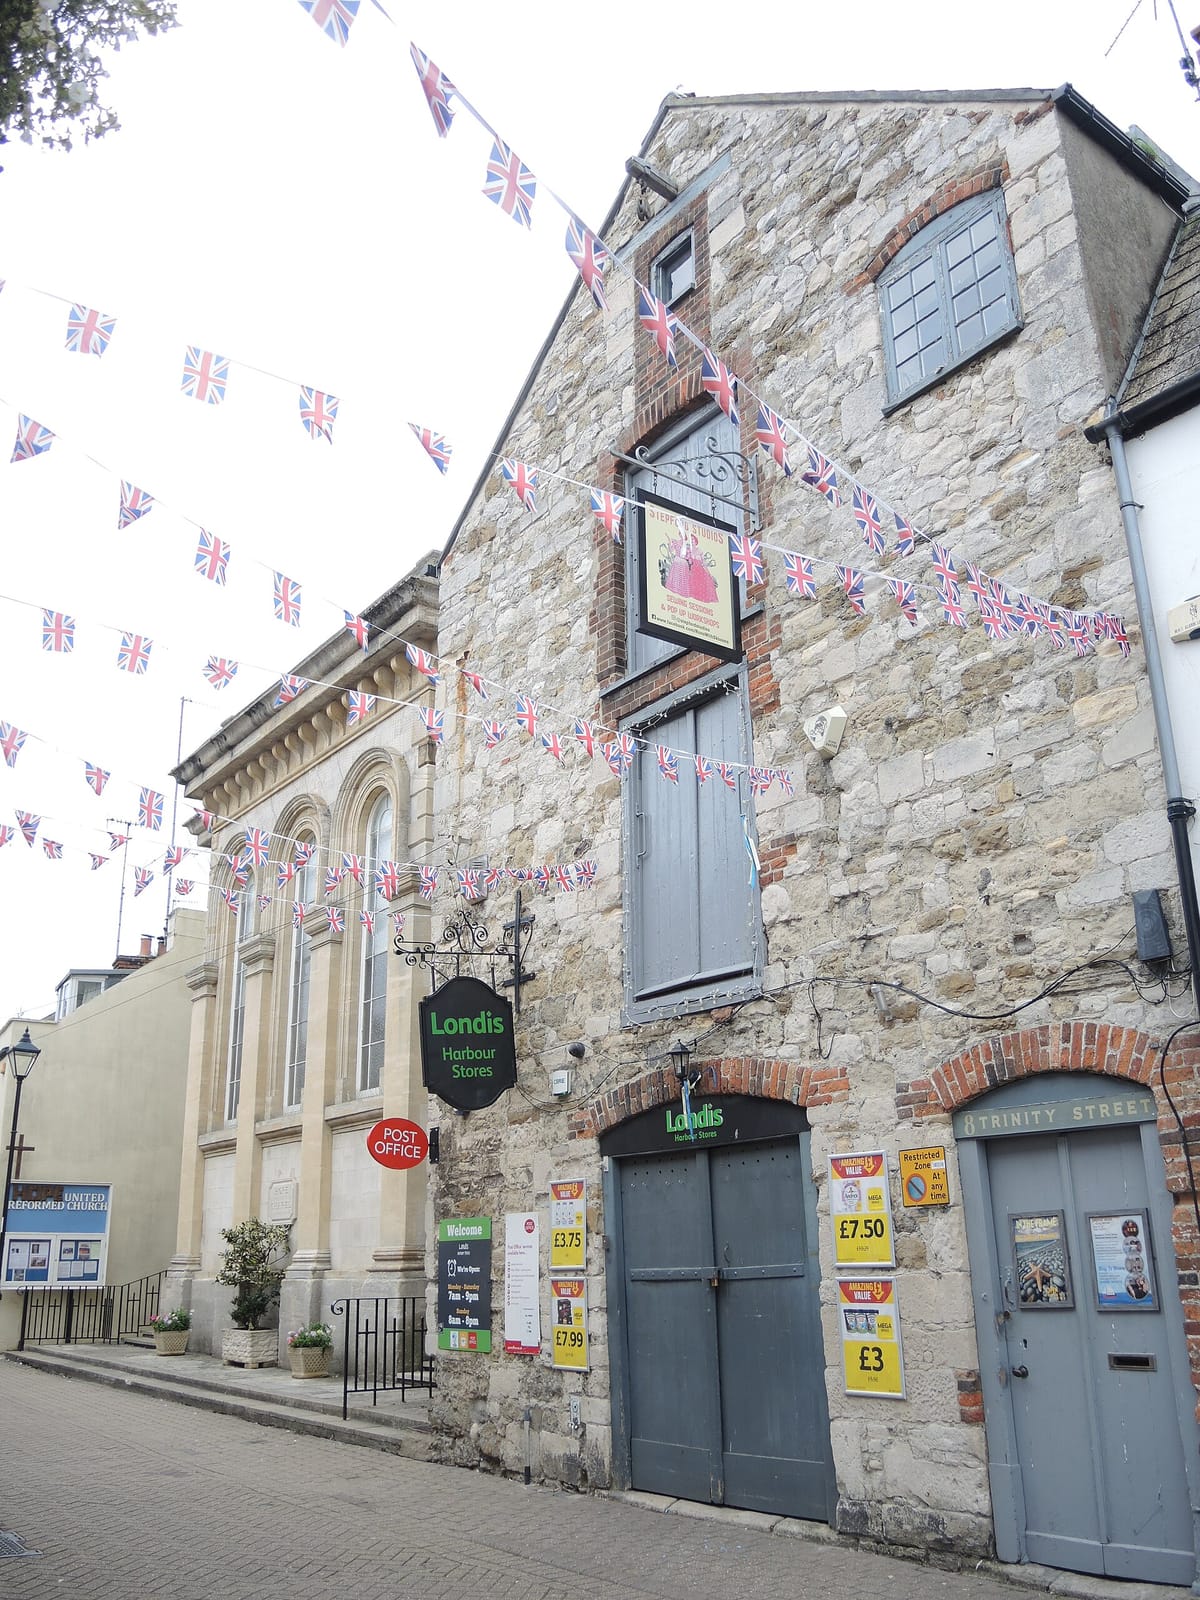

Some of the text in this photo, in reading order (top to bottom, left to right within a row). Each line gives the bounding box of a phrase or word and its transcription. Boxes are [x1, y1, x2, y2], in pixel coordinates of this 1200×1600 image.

[649, 509, 724, 545] STEPFOD STUDIOS
[430, 1010, 505, 1036] Londis
[442, 1046, 496, 1061] Harbour
[451, 1064, 494, 1079] Stores
[665, 1103, 724, 1133] Londis
[964, 1098, 1151, 1136] 8 TRINITY STREET
[383, 1127, 418, 1144] POST
[674, 1130, 718, 1142] Harbor Stores
[374, 1141, 421, 1159] OFFICE
[903, 1151, 940, 1162] Restricted
[841, 1157, 865, 1167] AMAZING
[914, 1162, 931, 1170] Zone
[845, 1166, 863, 1176] VALUE
[932, 1172, 941, 1180] At
[931, 1183, 943, 1191] any
[64, 1193, 105, 1202] UNITED
[930, 1192, 946, 1200] time
[7, 1200, 108, 1211] REFORMED CHURCH
[446, 1223, 483, 1237] Welcome
[839, 1218, 885, 1239] £7.50
[554, 1232, 581, 1248] £3.75
[848, 1282, 873, 1291] AMAZING
[448, 1291, 461, 1301] 7am
[465, 1291, 479, 1303] 9pm
[853, 1291, 872, 1300] VALUE
[556, 1330, 583, 1347] £7.99
[859, 1346, 884, 1372] £3
